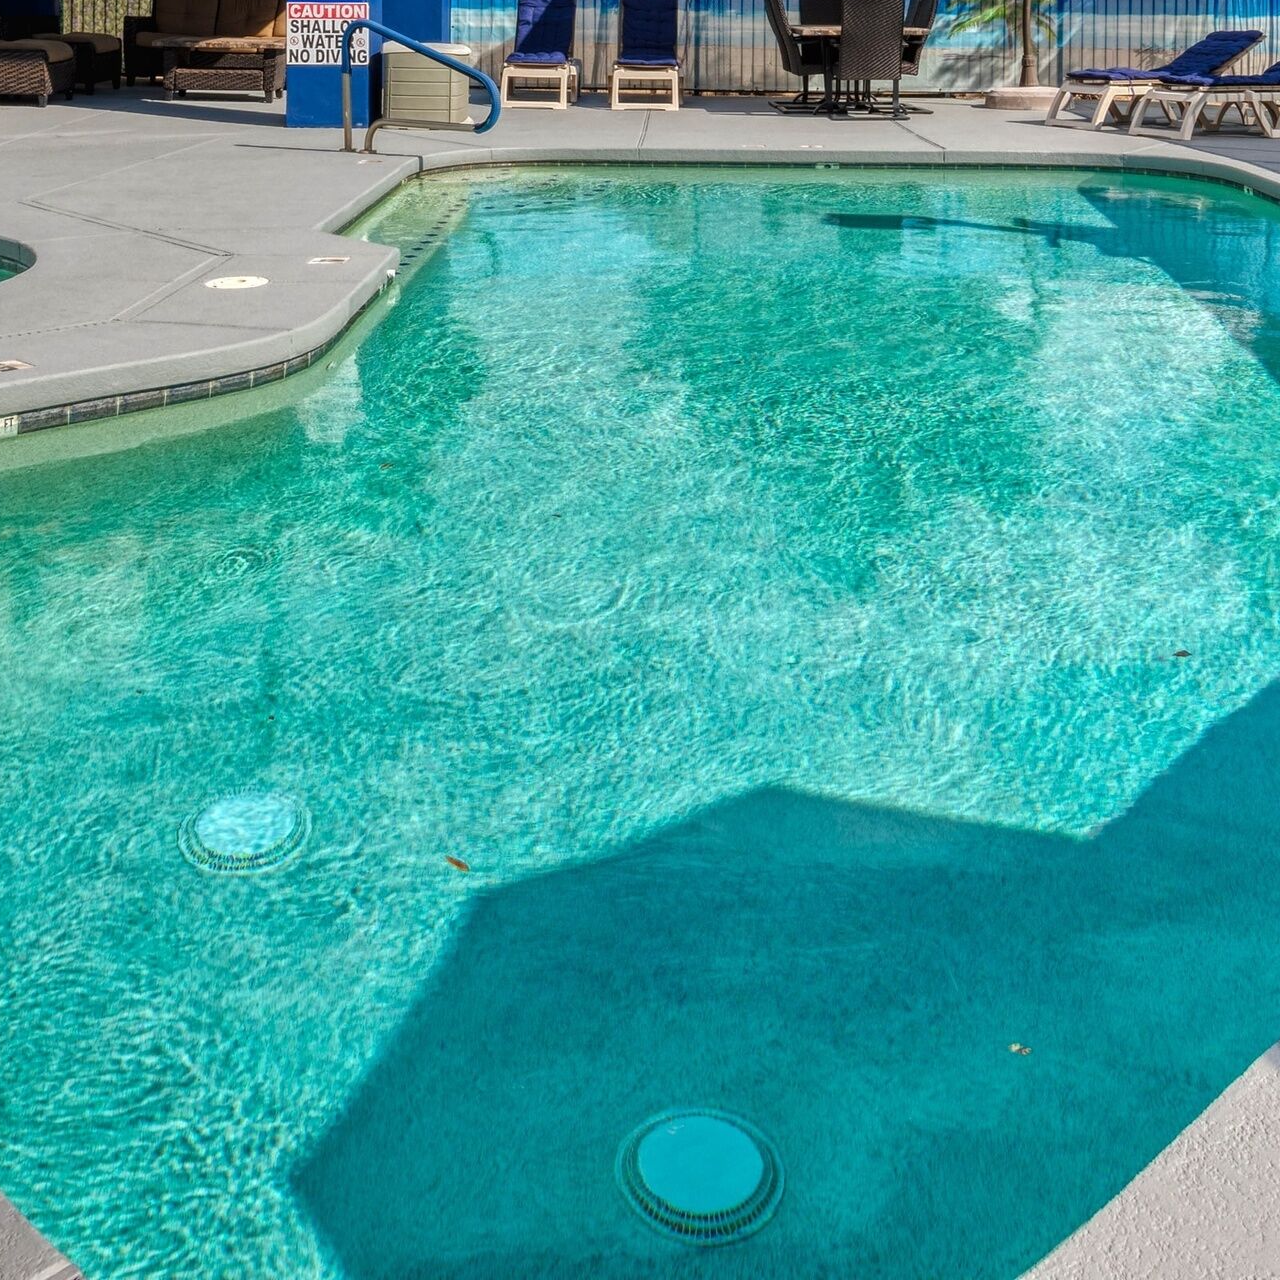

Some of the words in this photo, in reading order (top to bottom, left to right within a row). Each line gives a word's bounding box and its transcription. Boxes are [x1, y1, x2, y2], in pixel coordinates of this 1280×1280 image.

[289, 4, 366, 19] CAUTION
[290, 19, 363, 34] SHALLO
[289, 49, 310, 63] NO
[315, 49, 368, 64] DIVNG
[4, 417, 14, 428] FT
